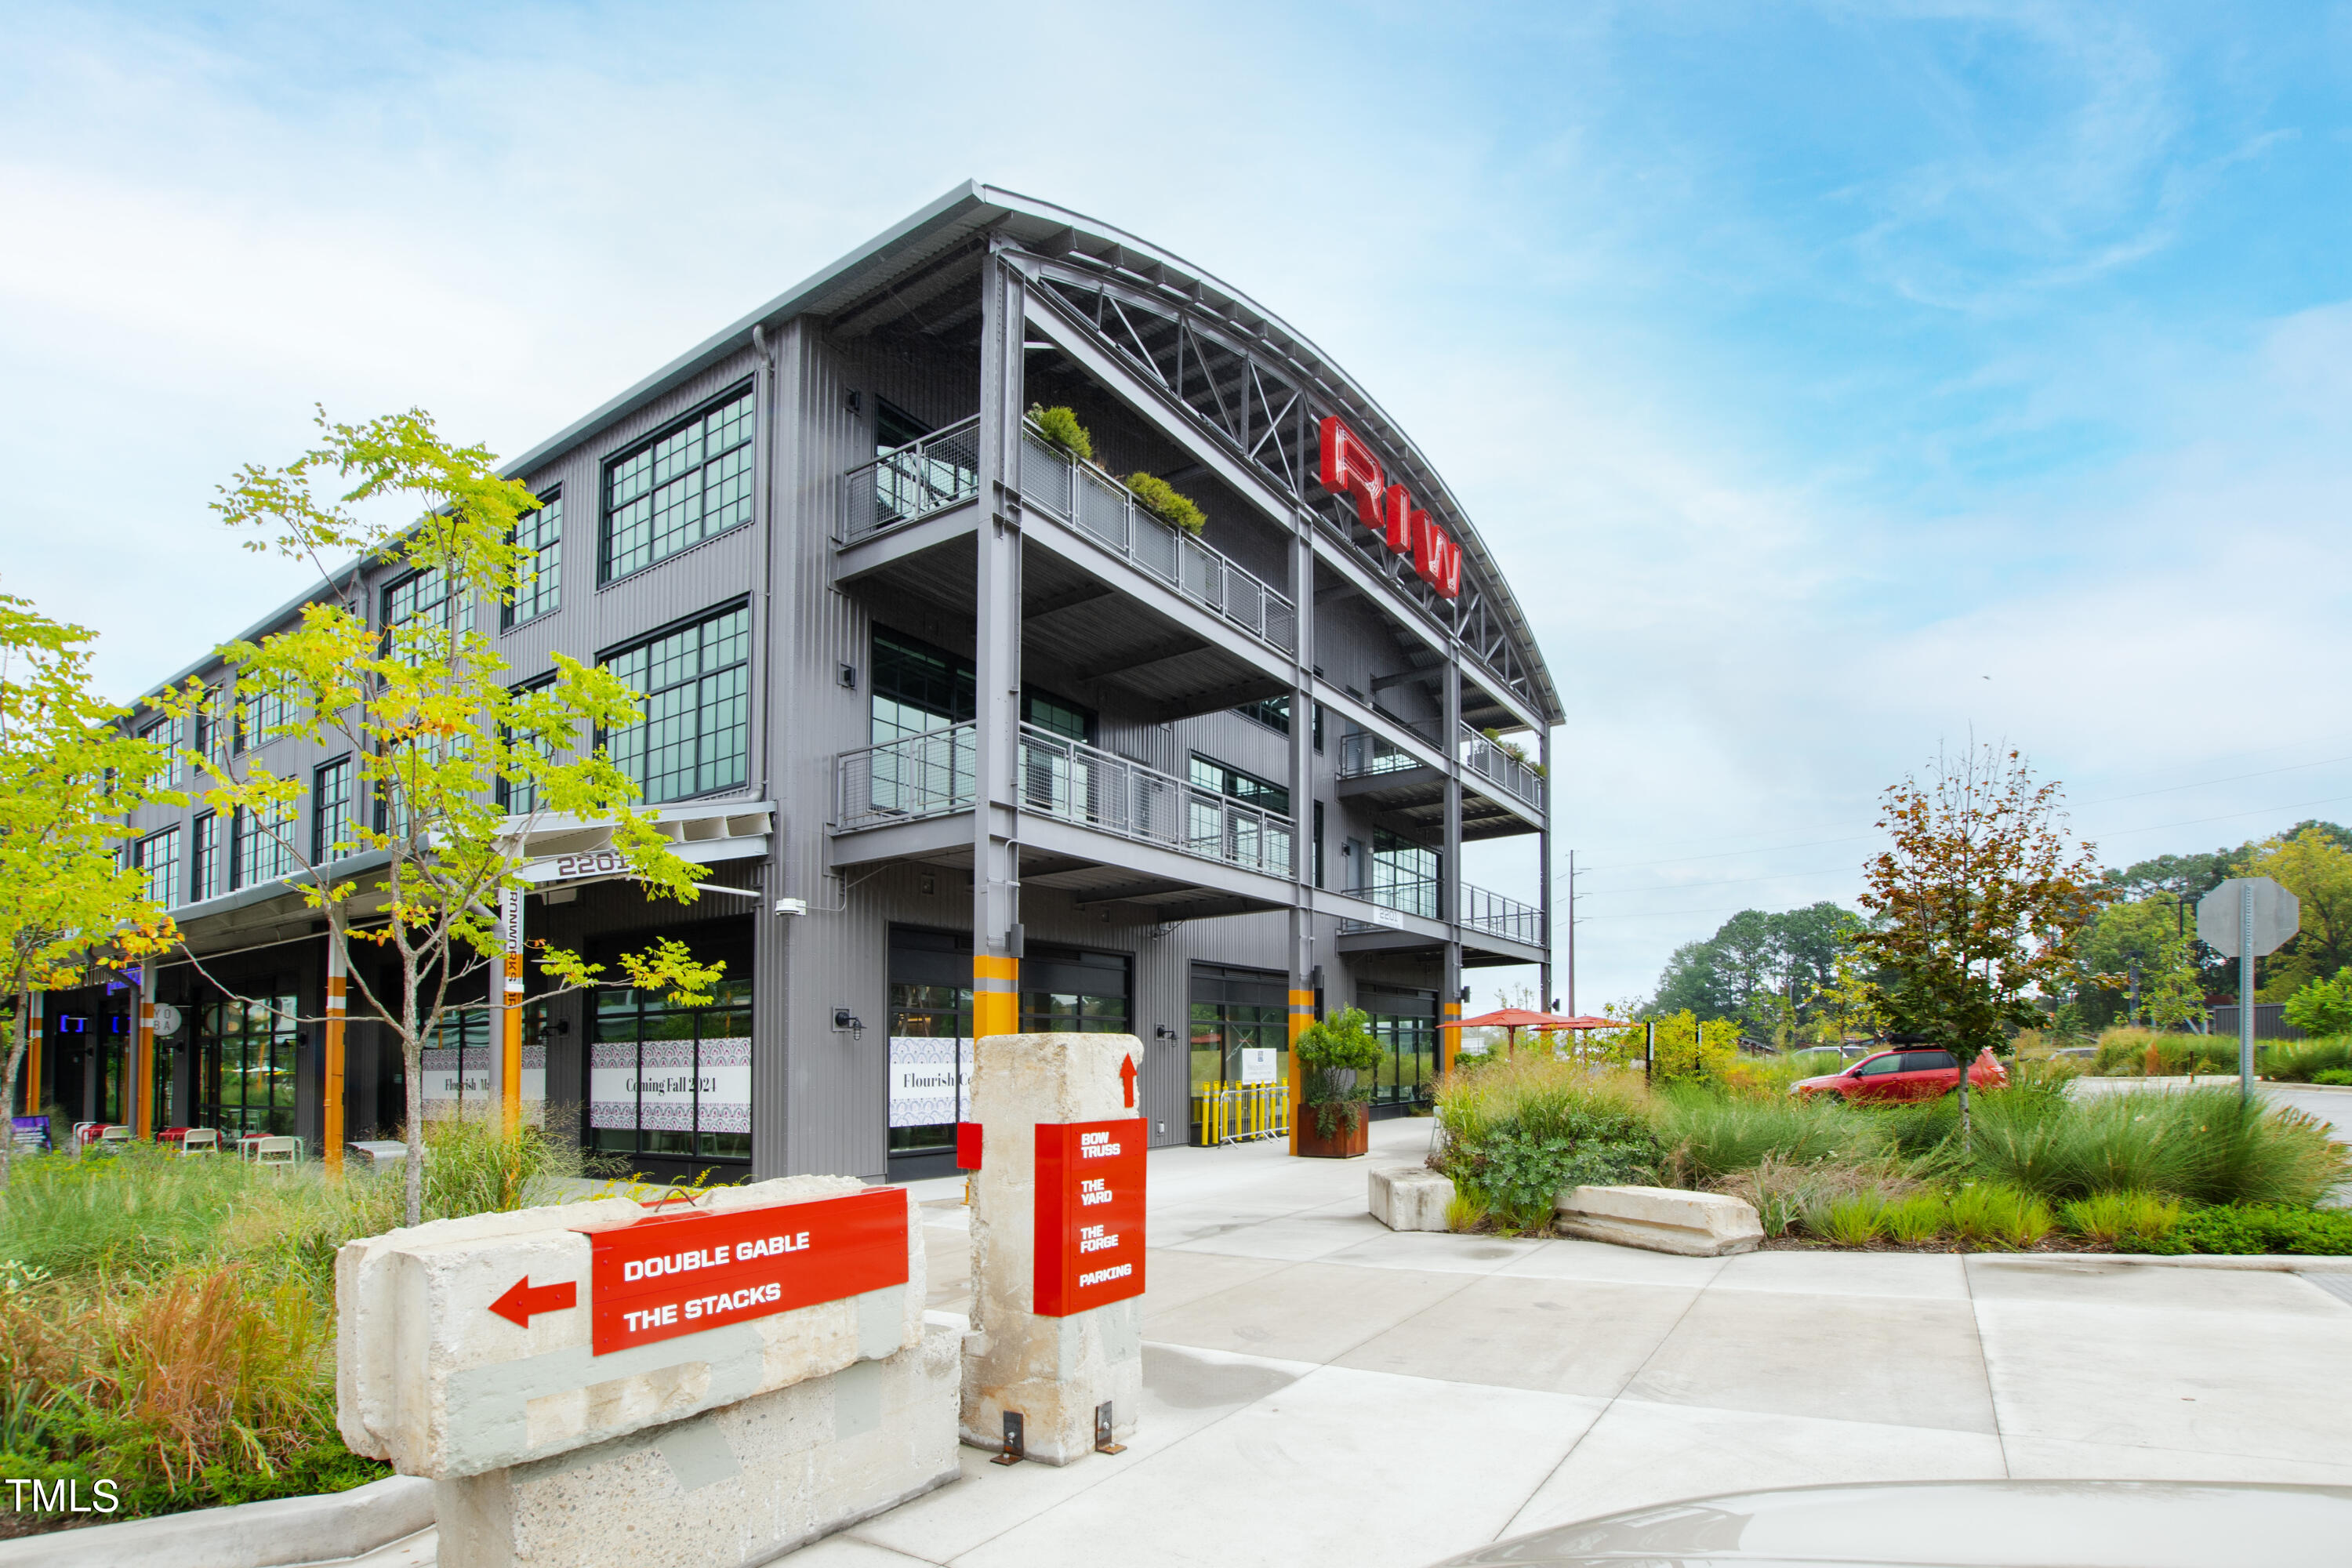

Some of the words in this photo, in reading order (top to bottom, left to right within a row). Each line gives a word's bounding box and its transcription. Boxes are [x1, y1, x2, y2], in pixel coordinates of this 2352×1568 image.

[1320, 415, 1462, 599] RIW
[557, 852, 630, 876] 2201
[1380, 908, 1399, 922] 2201
[508, 887, 518, 982] RONWORKS
[626, 1077, 665, 1097] Coming
[666, 1076, 686, 1092] Fall
[903, 1073, 955, 1087] Flourish
[1081, 1131, 1109, 1146] BOW
[1081, 1143, 1121, 1158] TRUSS
[1081, 1178, 1105, 1192] THE
[1081, 1190, 1112, 1206] YARD
[1080, 1225, 1104, 1240] THE
[1080, 1234, 1119, 1253] FORGE
[624, 1245, 730, 1282] DOUBLE
[736, 1232, 810, 1261] GABLE
[1080, 1264, 1132, 1287] PARKING
[623, 1304, 678, 1332] THE
[684, 1283, 781, 1319] STACKS
